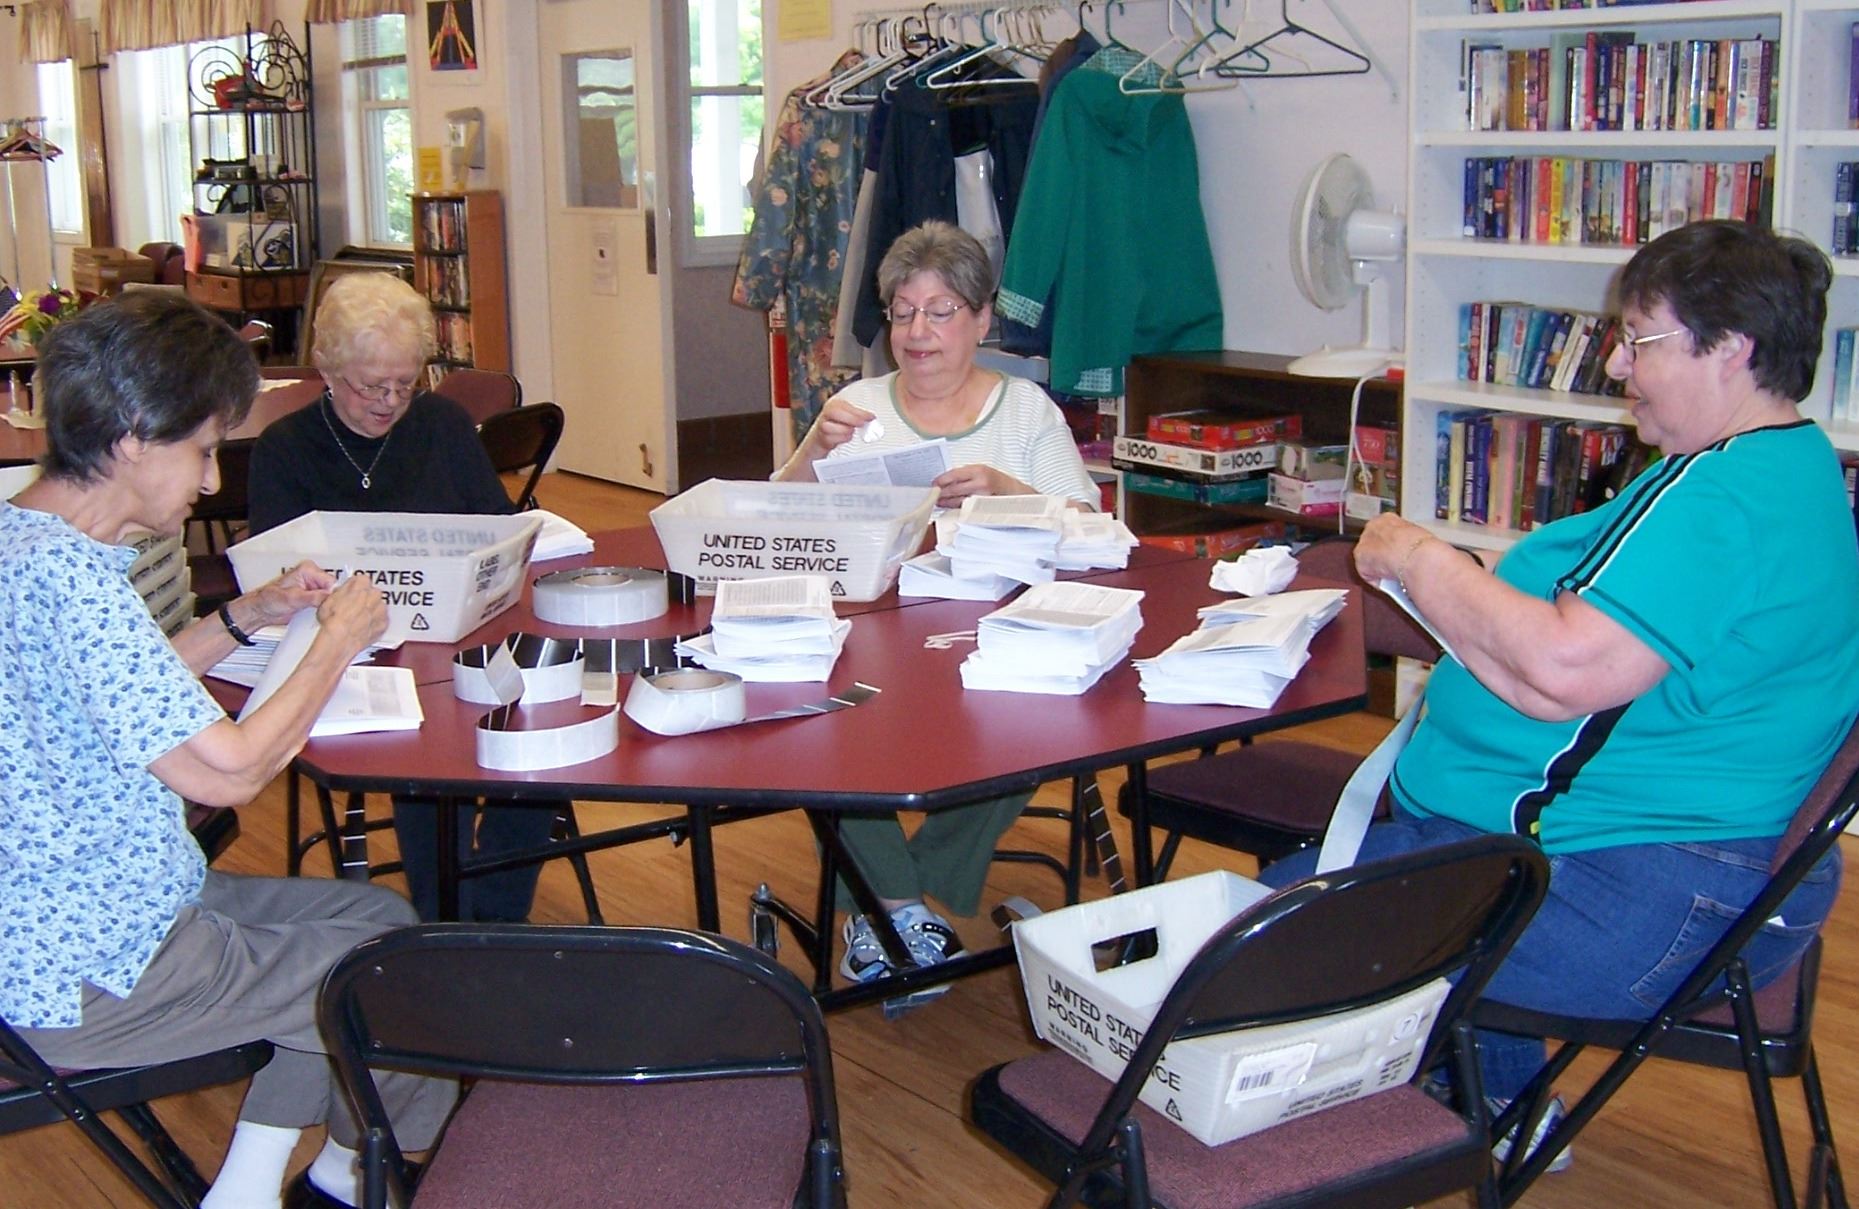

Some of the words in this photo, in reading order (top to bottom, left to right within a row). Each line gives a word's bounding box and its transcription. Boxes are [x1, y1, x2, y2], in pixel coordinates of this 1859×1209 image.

[1126, 441, 1157, 460] 1000
[1231, 451, 1263, 470] 1000
[703, 533, 766, 550] UNITED
[771, 537, 837, 553] STATES
[698, 552, 765, 570] POSTAL
[771, 556, 849, 572] SERVICE
[381, 591, 434, 607] RVICE
[1047, 974, 1101, 1022] UNITED
[1047, 995, 1104, 1048] POSTAL
[1108, 1037, 1182, 1092] SECE
